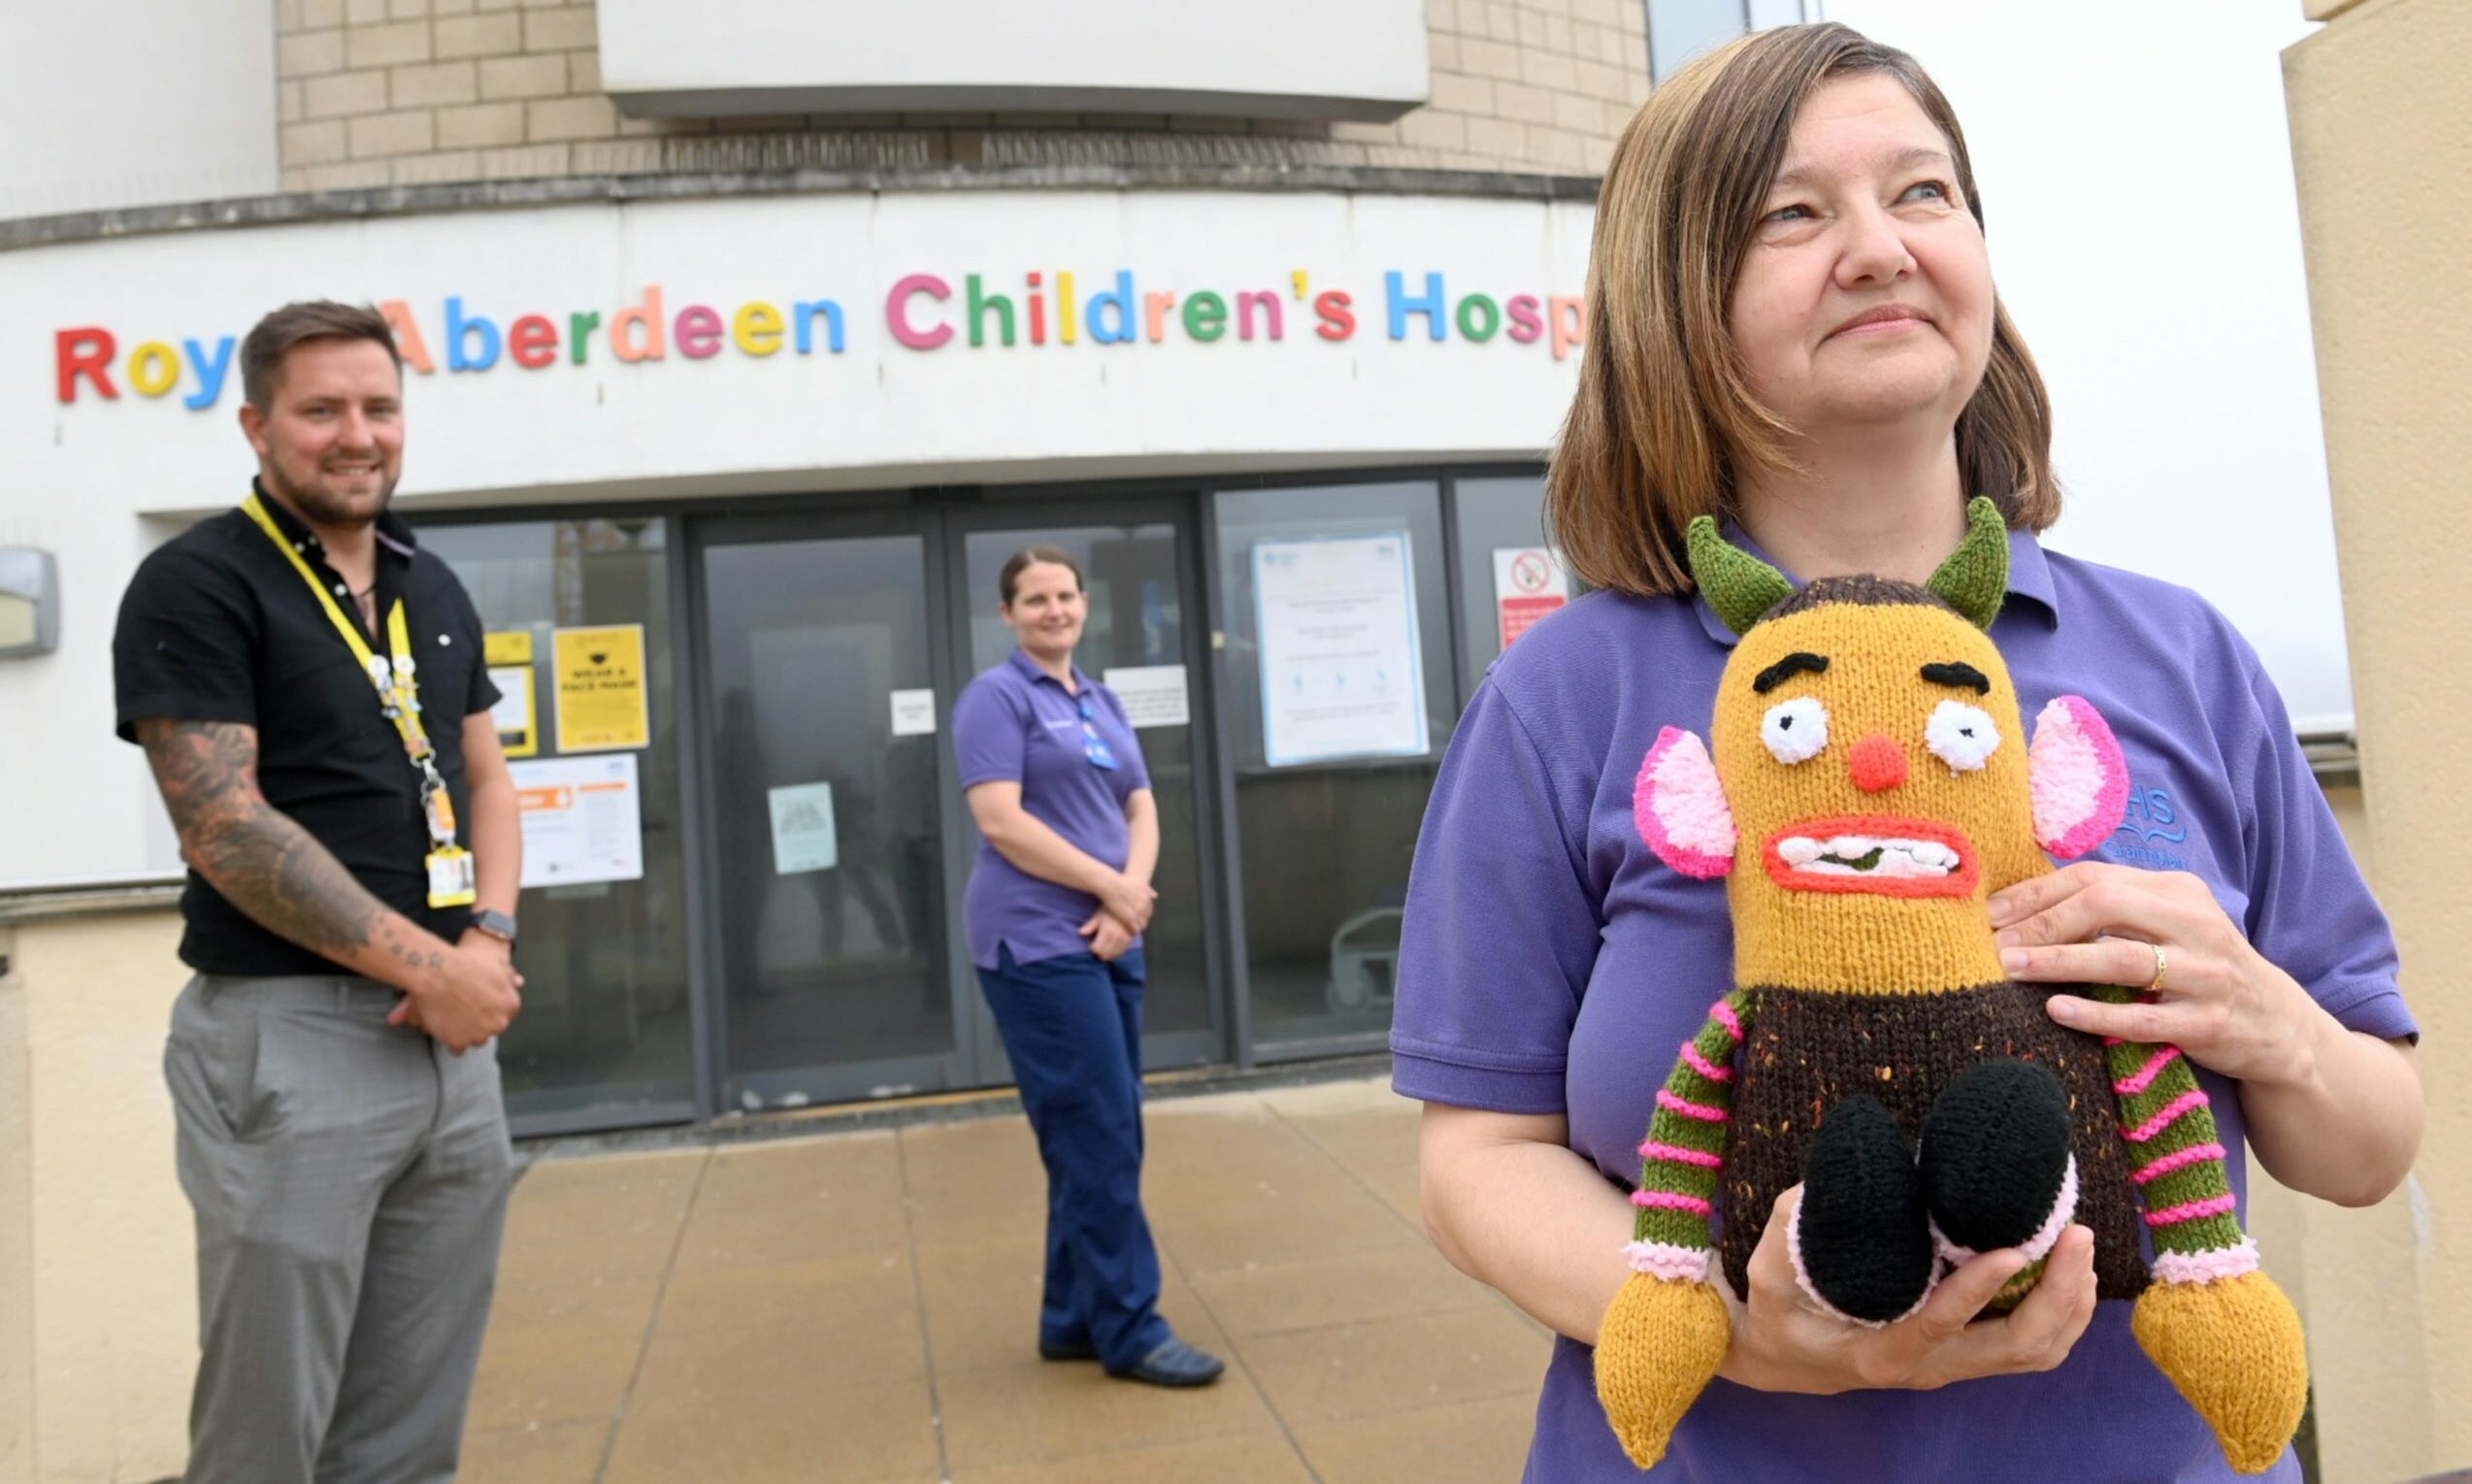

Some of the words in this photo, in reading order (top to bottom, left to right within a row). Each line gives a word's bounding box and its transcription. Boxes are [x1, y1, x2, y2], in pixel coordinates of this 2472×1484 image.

[55, 327, 236, 412] Roy
[379, 284, 844, 375] Aberdeen
[884, 270, 1356, 350] Children's
[1385, 271, 1586, 360] Hosp
[2126, 784, 2175, 826] HS
